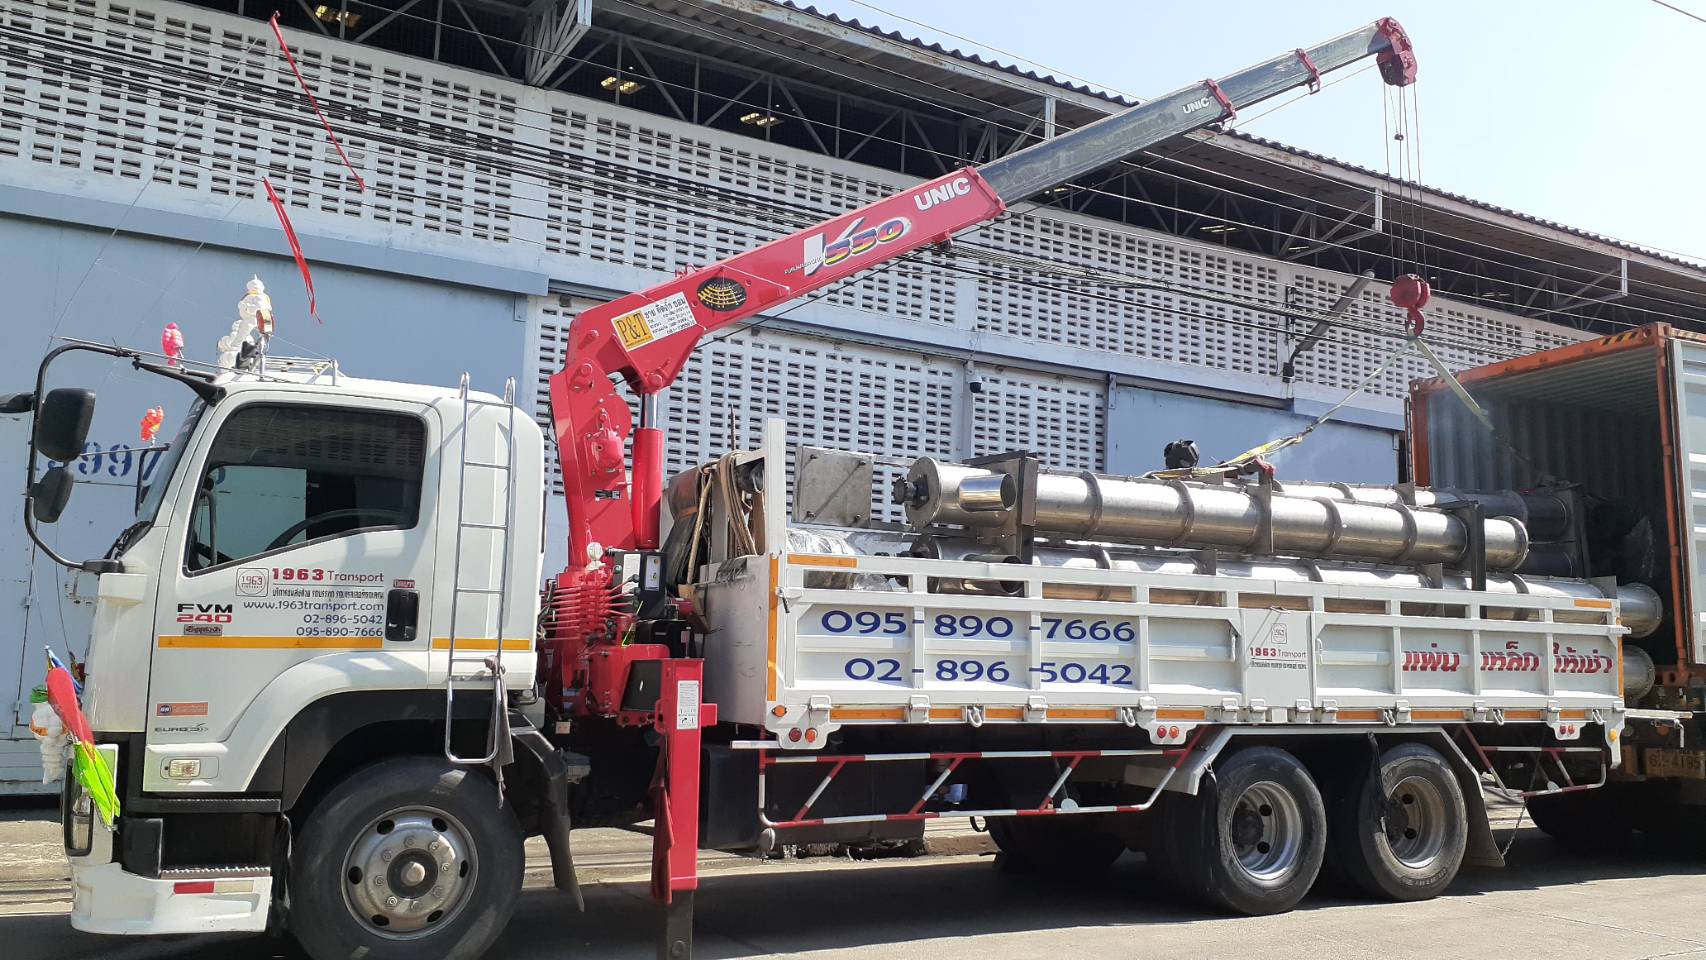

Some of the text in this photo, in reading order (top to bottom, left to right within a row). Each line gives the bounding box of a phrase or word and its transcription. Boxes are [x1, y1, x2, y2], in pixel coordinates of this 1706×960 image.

[1183, 97, 1210, 114] UNIC
[913, 177, 971, 211] UNIC
[616, 312, 648, 343] P&T
[241, 575, 263, 586] 1963
[271, 567, 325, 581] 1963
[327, 570, 384, 584] Transport
[177, 603, 233, 614] FVM
[243, 599, 384, 612] www.1963transport.com
[176, 613, 233, 623] 240
[303, 614, 383, 625] 02-896-5042
[295, 626, 384, 637] 095-890-7666
[1250, 647, 1307, 658] 1963 Transport
[1479, 641, 1540, 672] เหล็ก
